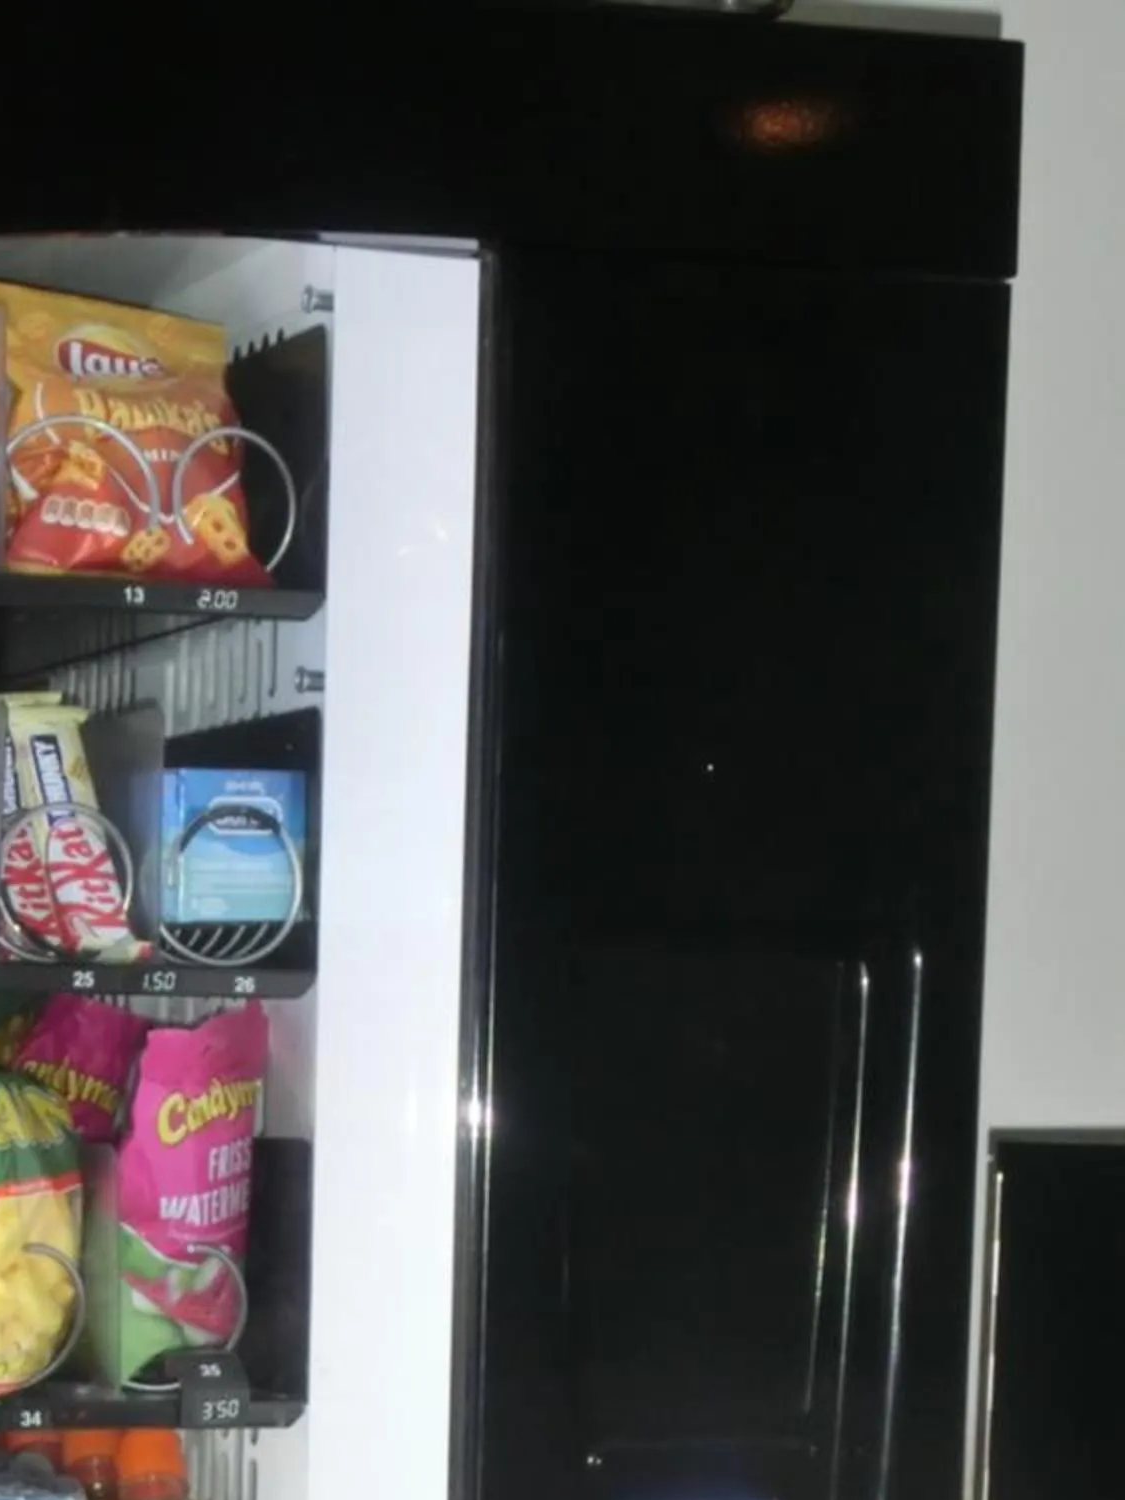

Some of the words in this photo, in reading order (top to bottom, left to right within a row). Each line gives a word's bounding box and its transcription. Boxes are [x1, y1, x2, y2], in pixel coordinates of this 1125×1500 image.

[125, 587, 144, 604] 13
[73, 971, 94, 988] 25
[235, 976, 255, 993] 26
[21, 1411, 41, 1427] 34
